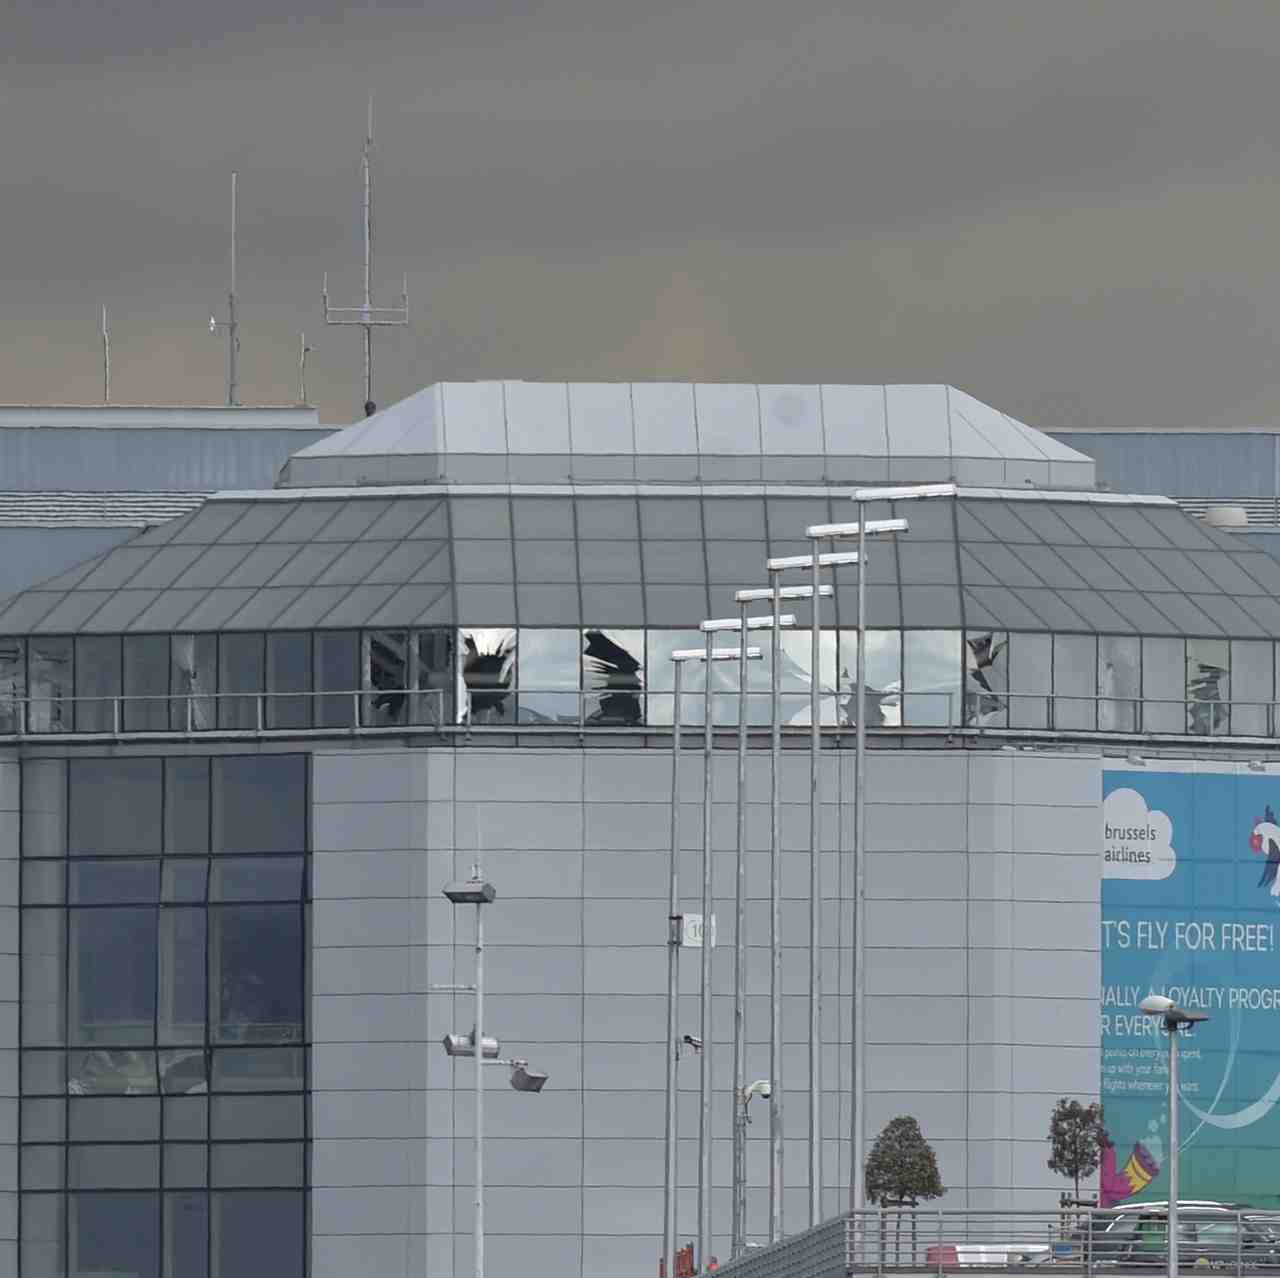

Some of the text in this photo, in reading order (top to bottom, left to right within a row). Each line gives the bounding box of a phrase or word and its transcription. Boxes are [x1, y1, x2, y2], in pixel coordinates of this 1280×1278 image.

[1104, 823, 1157, 842] brussels
[1104, 845, 1152, 865] airlines
[1136, 921, 1168, 950] FLY
[1175, 922, 1217, 951] FOR
[1221, 923, 1275, 953] FREE!
